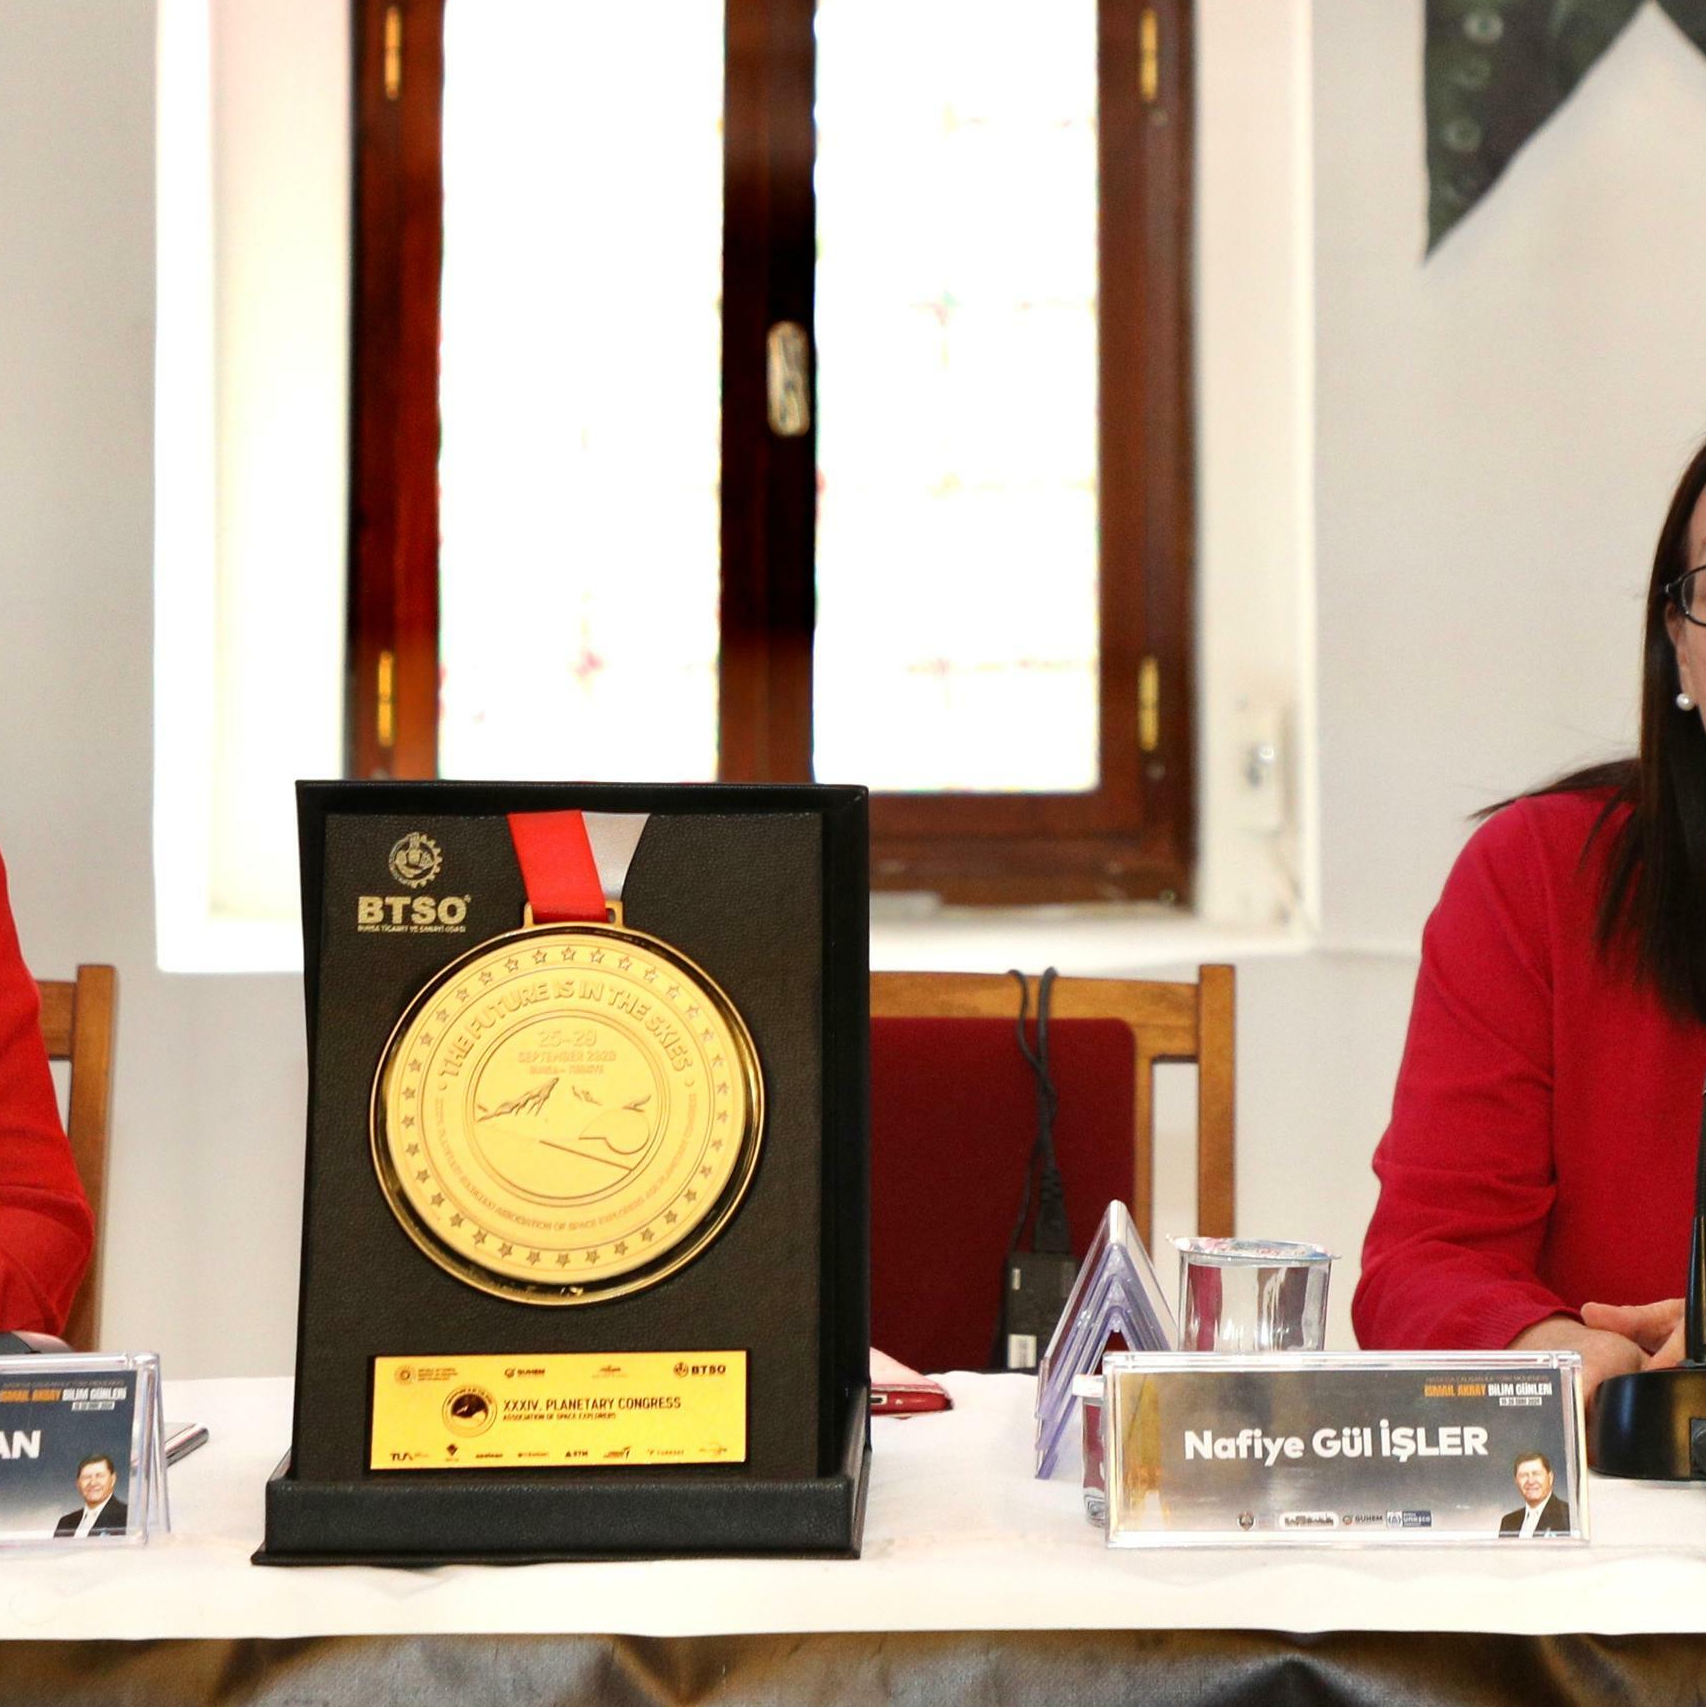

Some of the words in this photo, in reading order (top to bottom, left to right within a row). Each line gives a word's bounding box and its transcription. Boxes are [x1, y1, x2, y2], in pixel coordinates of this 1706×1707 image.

[357, 895, 467, 925] BTSO
[440, 1036, 474, 1077] THE
[470, 982, 550, 1041] FUTURE
[550, 980, 575, 999] IS
[579, 980, 606, 1002] IN
[608, 987, 651, 1022] THE
[645, 1013, 693, 1073] SKIES
[691, 1364, 727, 1376] BTSO
[503, 1399, 542, 1411] XXXIV.
[546, 1397, 615, 1410] PLANETARY
[618, 1396, 681, 1409] CONGRESS
[1184, 1427, 1304, 1466] Nafiye
[1311, 1425, 1372, 1458] Gül
[1380, 1418, 1488, 1463] İŞLER
